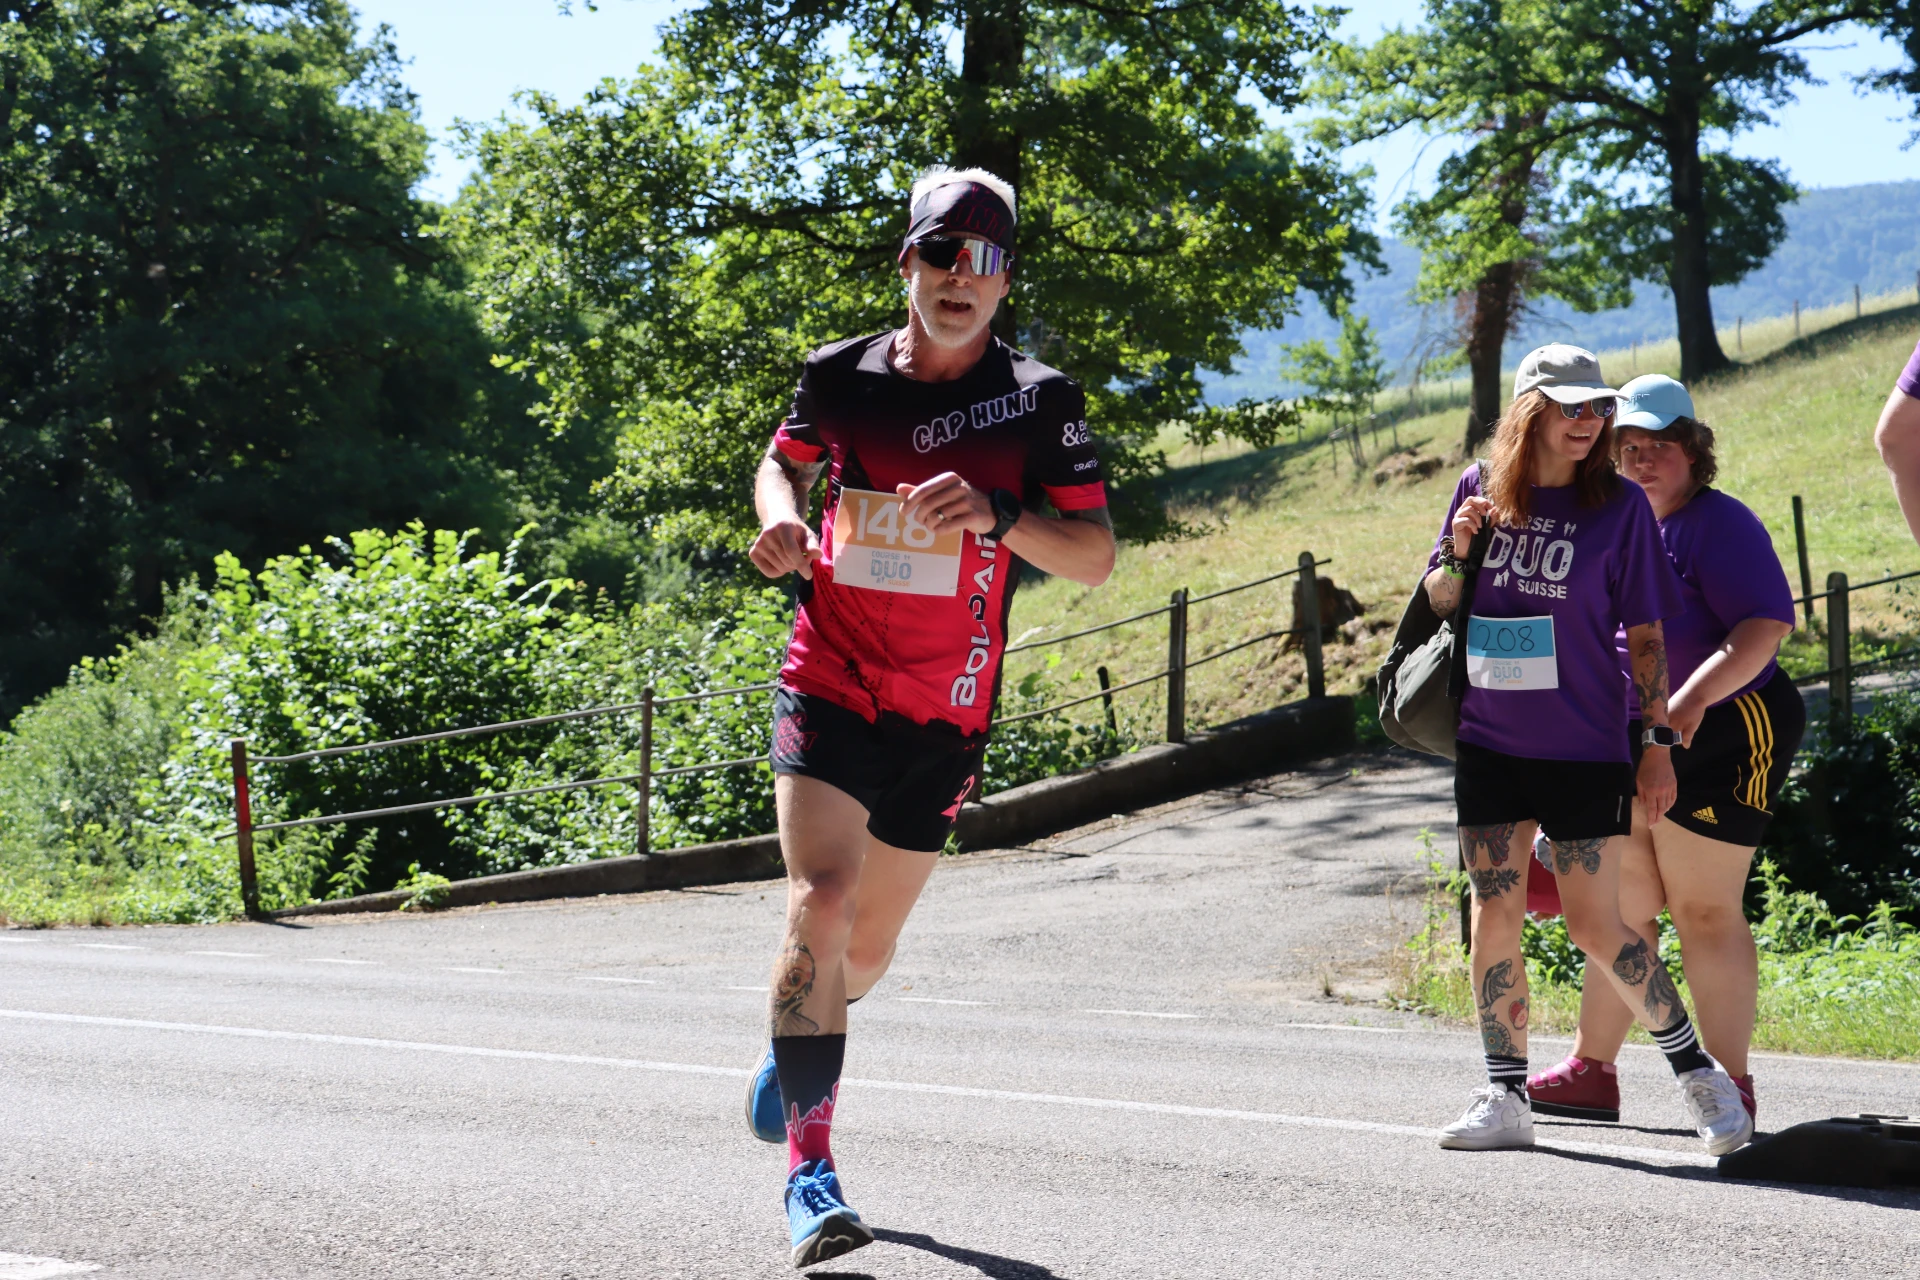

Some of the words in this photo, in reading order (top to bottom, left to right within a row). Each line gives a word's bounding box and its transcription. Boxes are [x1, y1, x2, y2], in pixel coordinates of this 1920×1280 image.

[913, 410, 966, 454] CAP
[970, 384, 1040, 429] HUNT
[1061, 422, 1081, 447] &
[856, 498, 936, 548] 148
[871, 550, 901, 561] COURSE
[1481, 526, 1575, 582] DUO
[870, 558, 912, 581] DUO
[1516, 578, 1568, 600] SUISSE
[1476, 624, 1535, 652] 208
[1492, 665, 1523, 679] DUO
[1692, 811, 1718, 825] adidas
